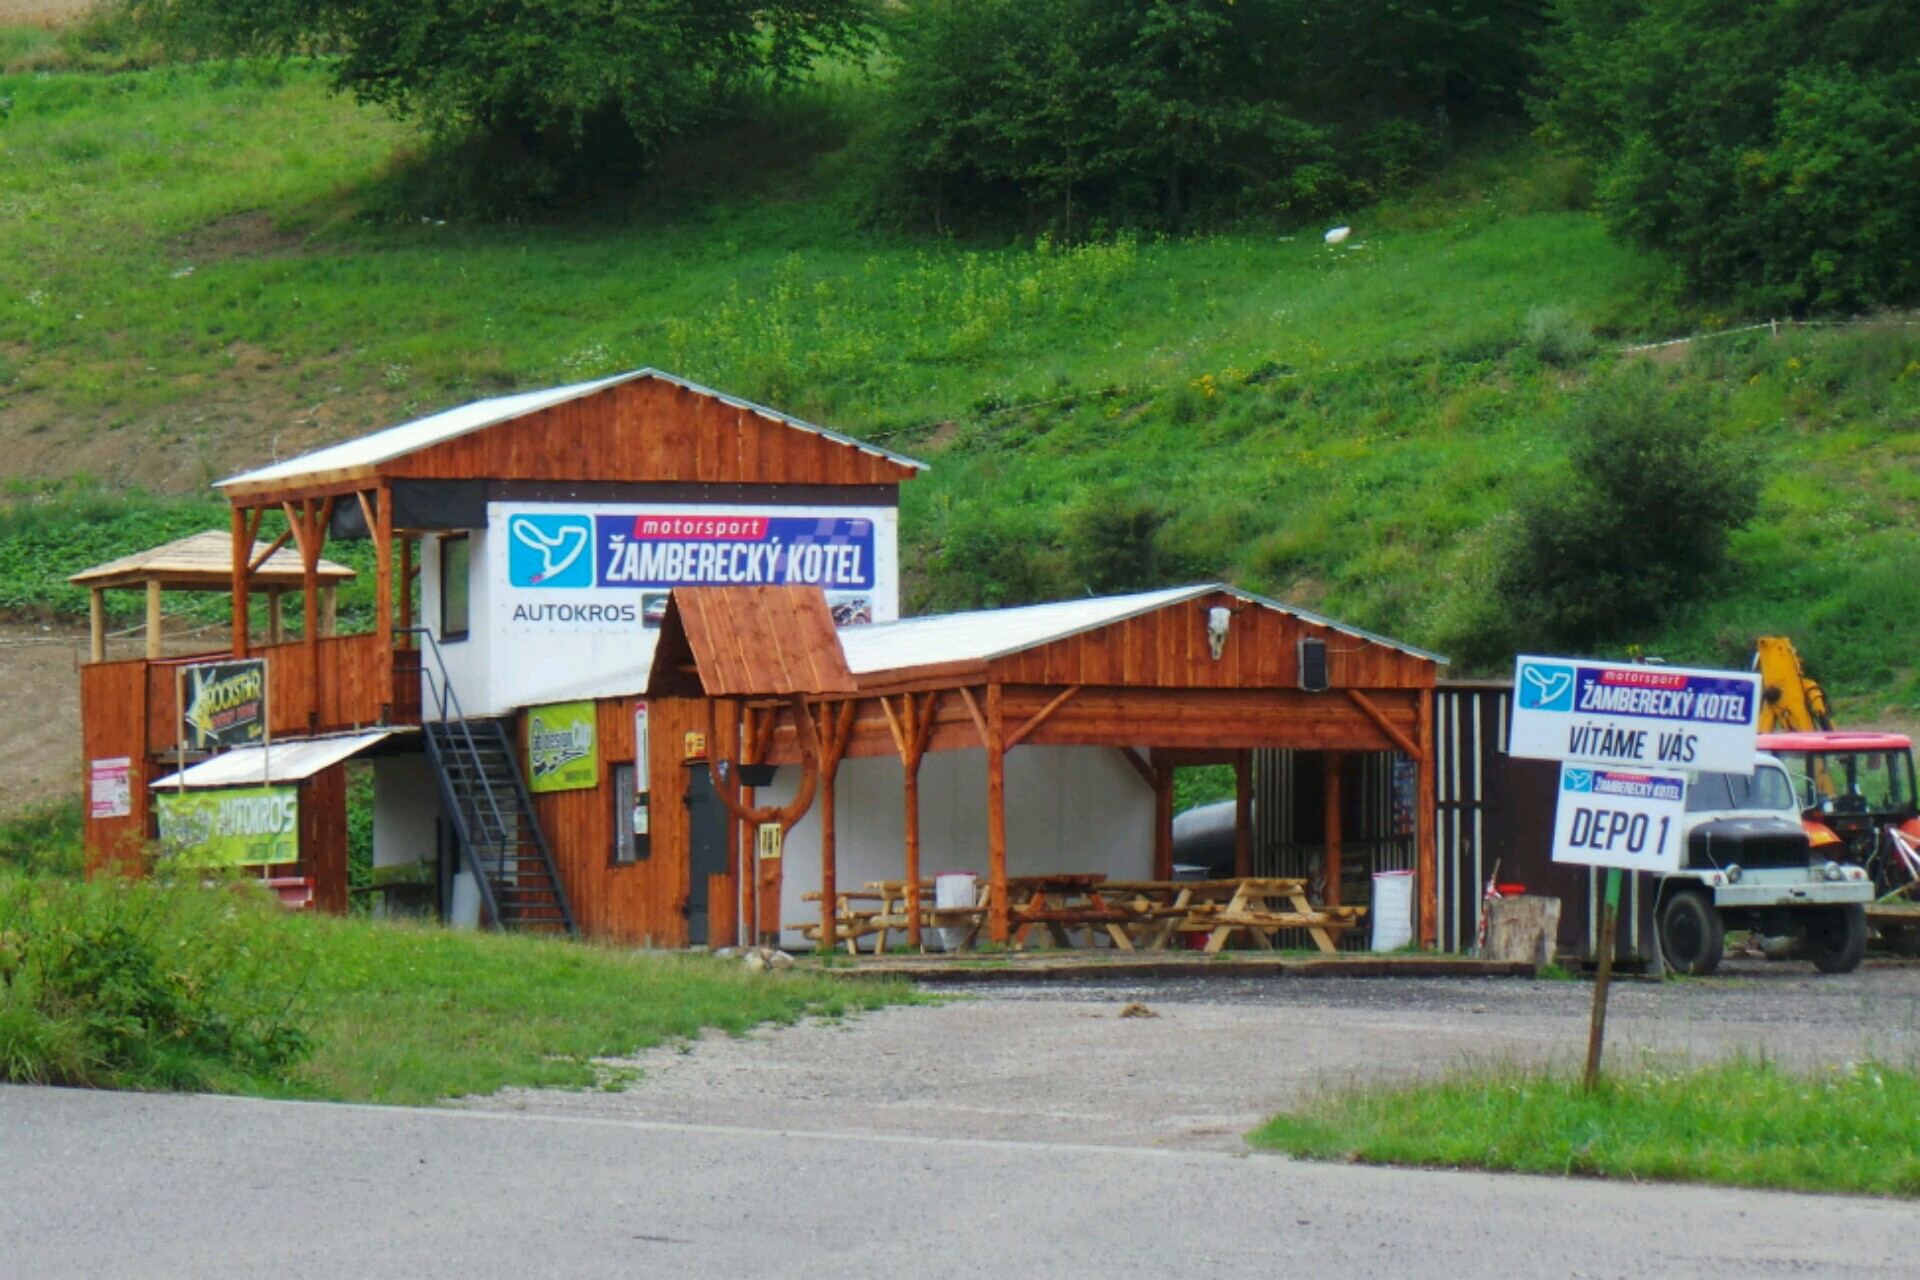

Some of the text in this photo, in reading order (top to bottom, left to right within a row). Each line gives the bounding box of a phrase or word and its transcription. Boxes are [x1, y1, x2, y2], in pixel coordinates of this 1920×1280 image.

[642, 519, 760, 537] motorsport
[605, 534, 866, 584] ŽAMBERECKÝ KOTEL
[512, 603, 636, 622] AUTOKROS
[1605, 671, 1681, 686] motorsport
[1580, 680, 1746, 721] ŽAMBERECKÝ KOTEL
[1568, 721, 1699, 763] VÍTÁME VÁS
[216, 794, 298, 836] AUTOKROS
[1568, 807, 1671, 856] DEPO 1
